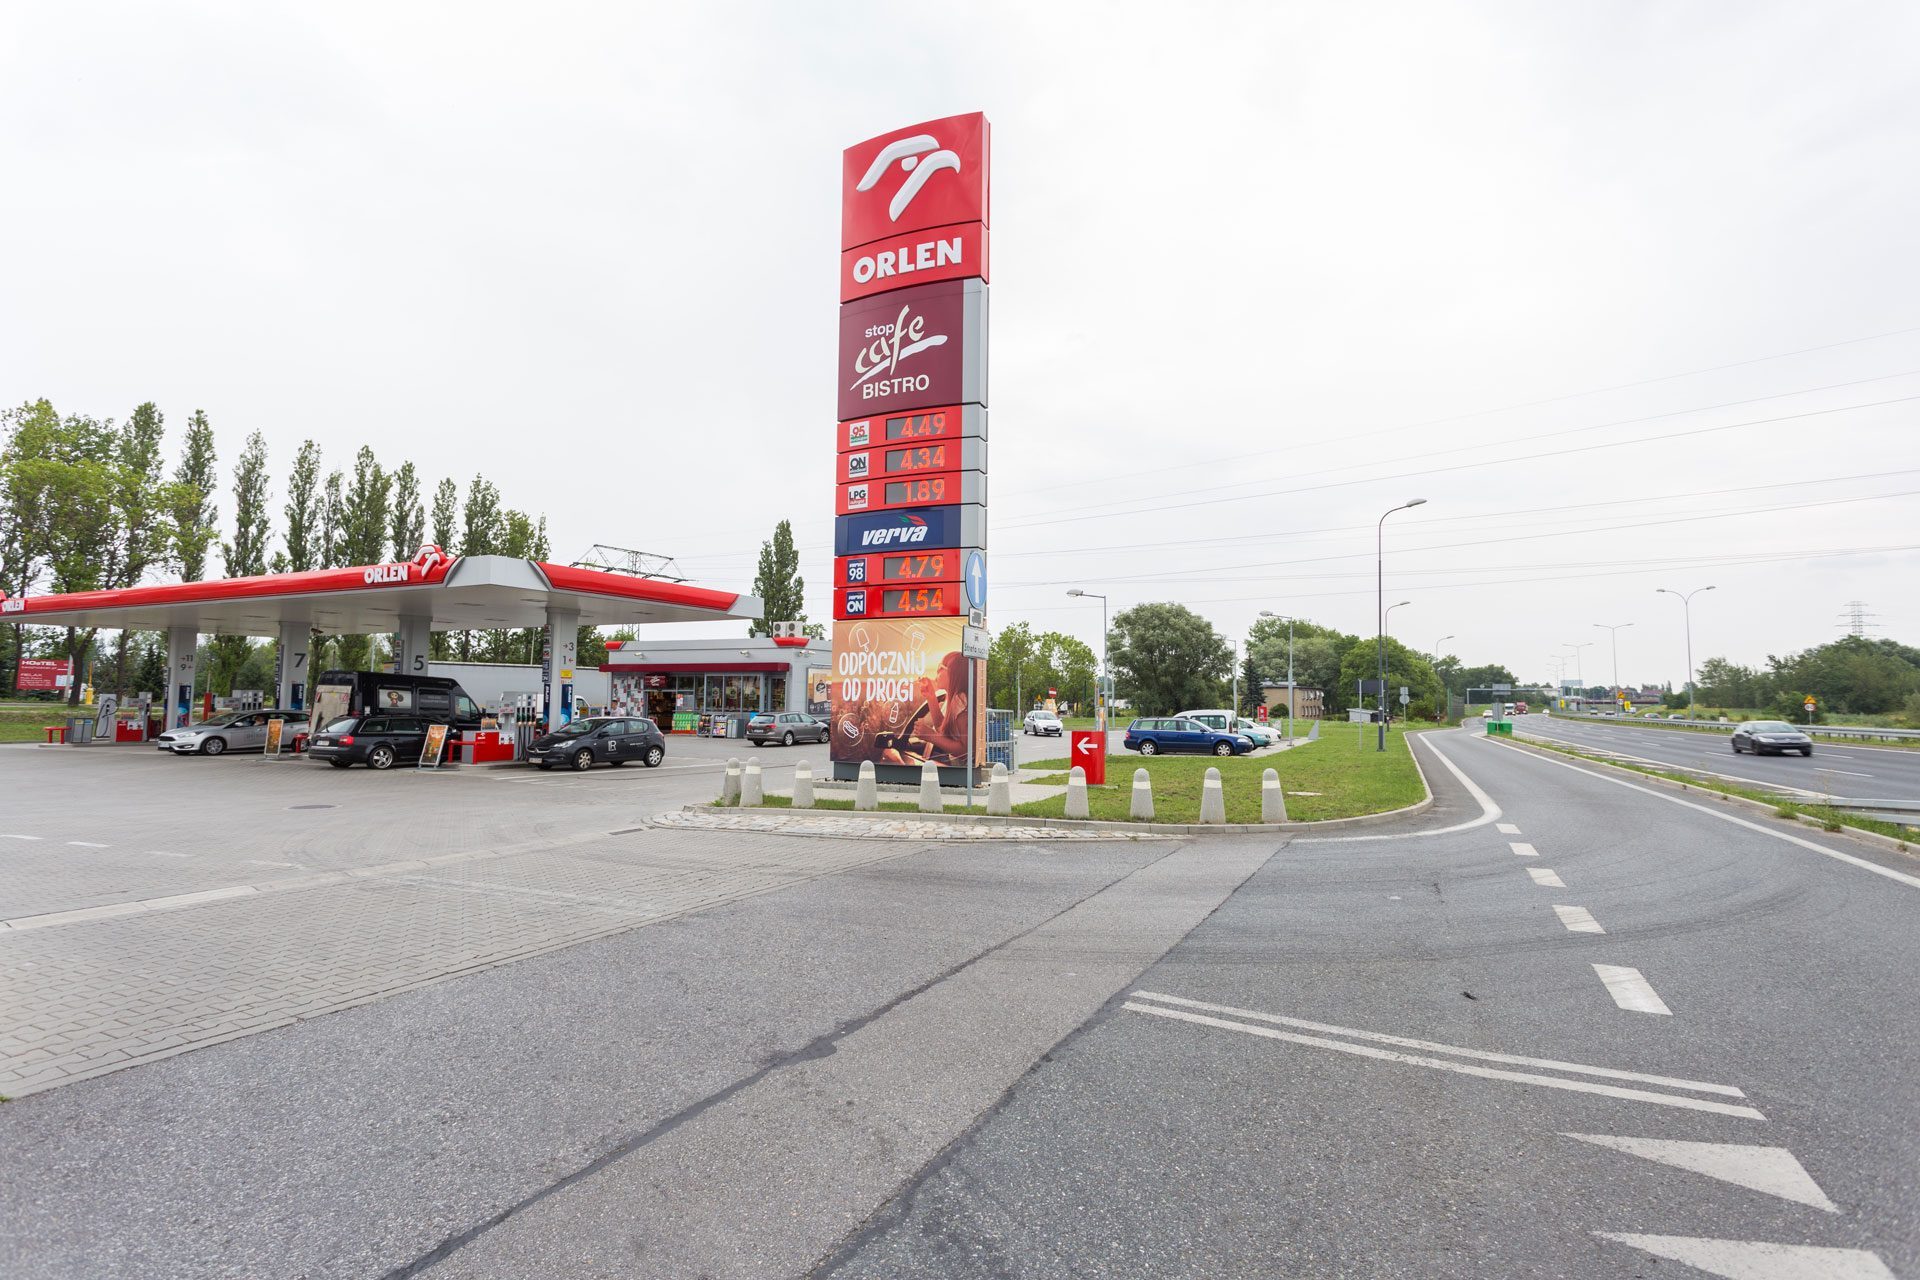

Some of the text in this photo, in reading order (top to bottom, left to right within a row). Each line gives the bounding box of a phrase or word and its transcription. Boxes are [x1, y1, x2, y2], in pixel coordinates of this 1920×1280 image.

[852, 237, 963, 284] ORLEN
[865, 323, 895, 338] stop
[862, 374, 930, 400] BISTRO
[852, 425, 866, 438] 95
[901, 413, 946, 437] 4.49
[850, 456, 867, 470] ON
[901, 445, 945, 470] 4.34
[849, 489, 867, 500] LPG
[903, 478, 945, 503] 1.89
[862, 525, 928, 546] verva
[364, 565, 409, 584] ORLEN
[849, 569, 864, 581] 98
[899, 555, 944, 578] 4.79
[847, 601, 864, 613] ON
[898, 588, 944, 612] 4.54
[568, 641, 575, 651] 3
[294, 652, 306, 668] 7
[413, 655, 424, 671] 5
[842, 679, 862, 701] OD
[866, 678, 914, 702] DROGI
